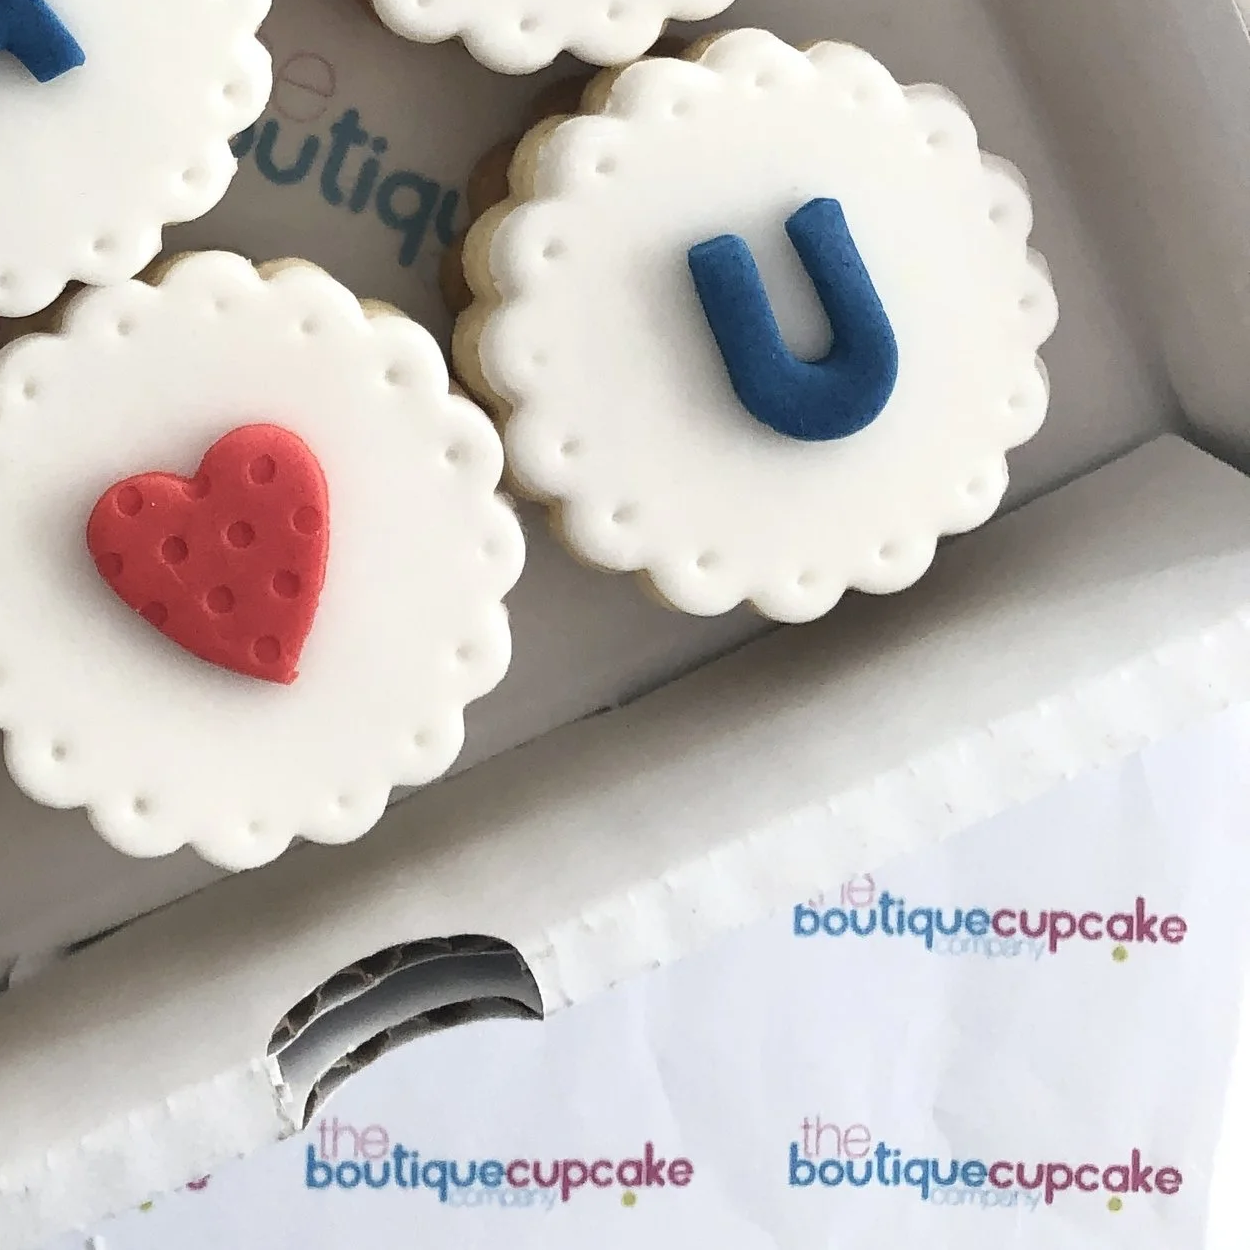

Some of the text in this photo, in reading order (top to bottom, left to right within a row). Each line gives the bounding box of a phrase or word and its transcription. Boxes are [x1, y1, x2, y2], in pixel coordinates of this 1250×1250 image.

[689, 199, 898, 441] U
[317, 1117, 390, 1160] the
[800, 1113, 871, 1158] the
